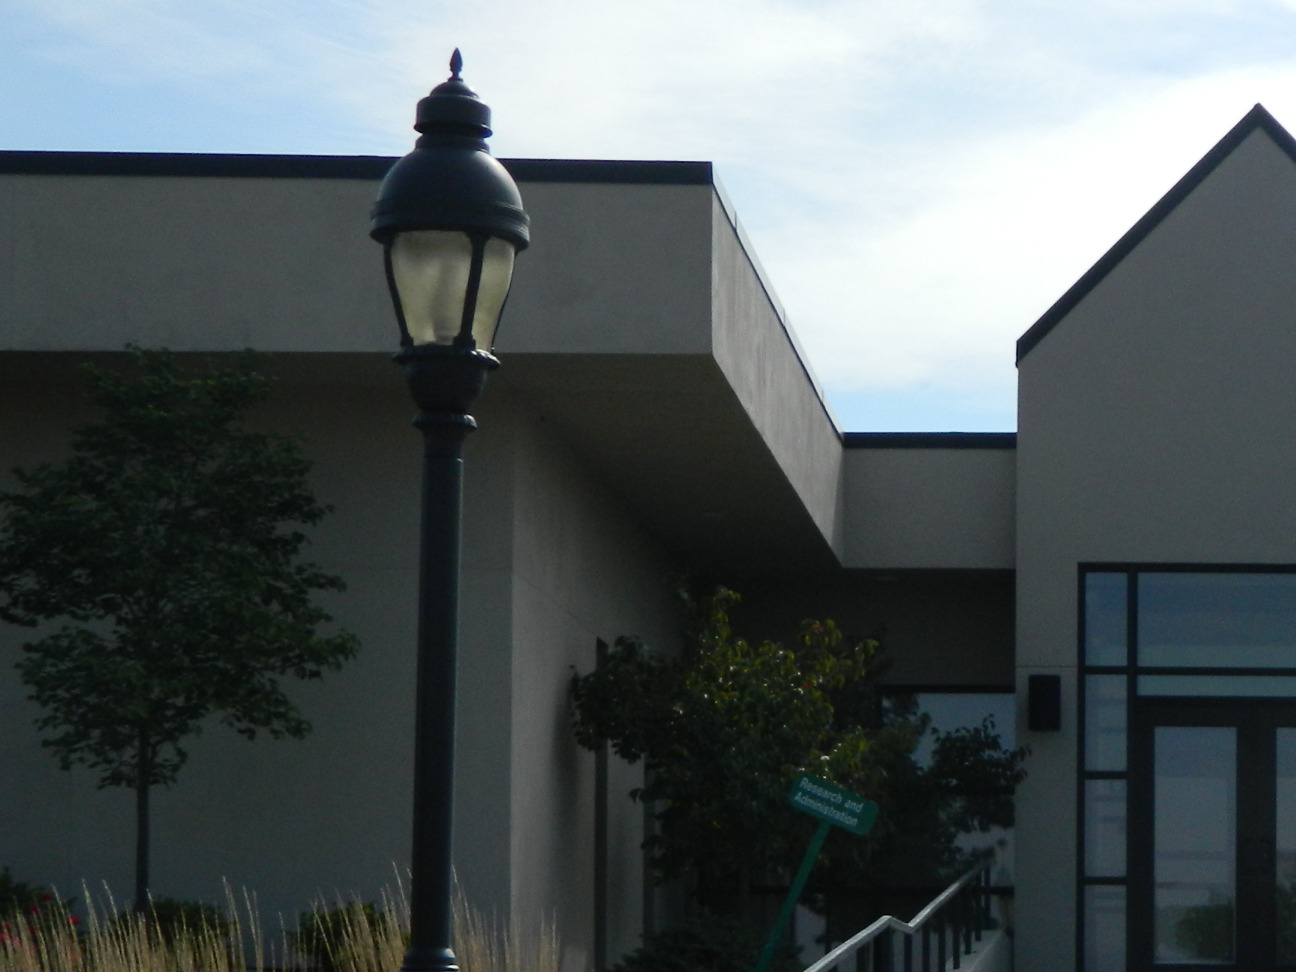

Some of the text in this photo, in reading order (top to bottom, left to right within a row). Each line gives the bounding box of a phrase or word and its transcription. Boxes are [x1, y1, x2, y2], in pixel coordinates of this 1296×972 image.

[793, 792, 858, 826] Administration
[799, 777, 864, 813] Research and
